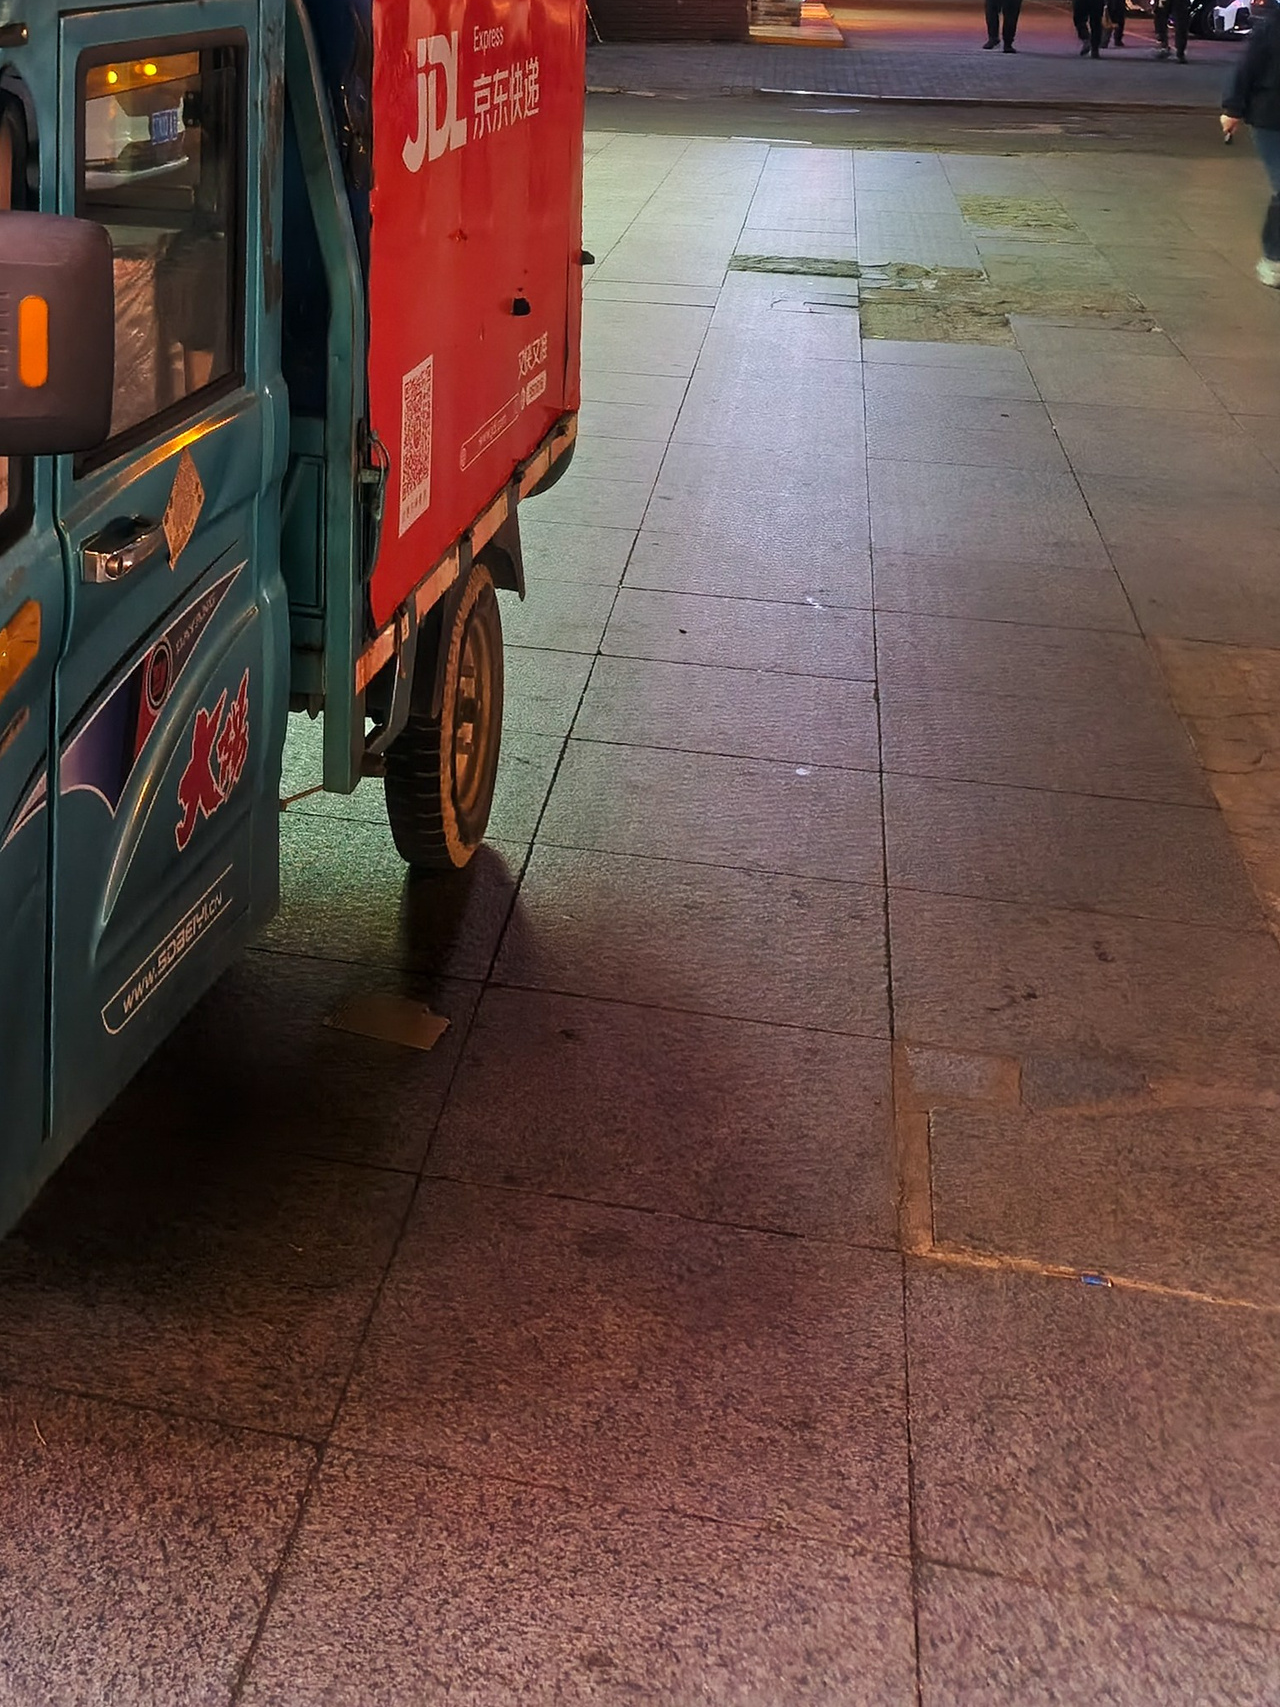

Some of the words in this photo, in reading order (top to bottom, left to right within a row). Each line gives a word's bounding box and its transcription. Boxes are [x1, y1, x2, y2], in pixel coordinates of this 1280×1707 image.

[473, 25, 504, 56] Express
[473, 56, 540, 140] 京东快递
